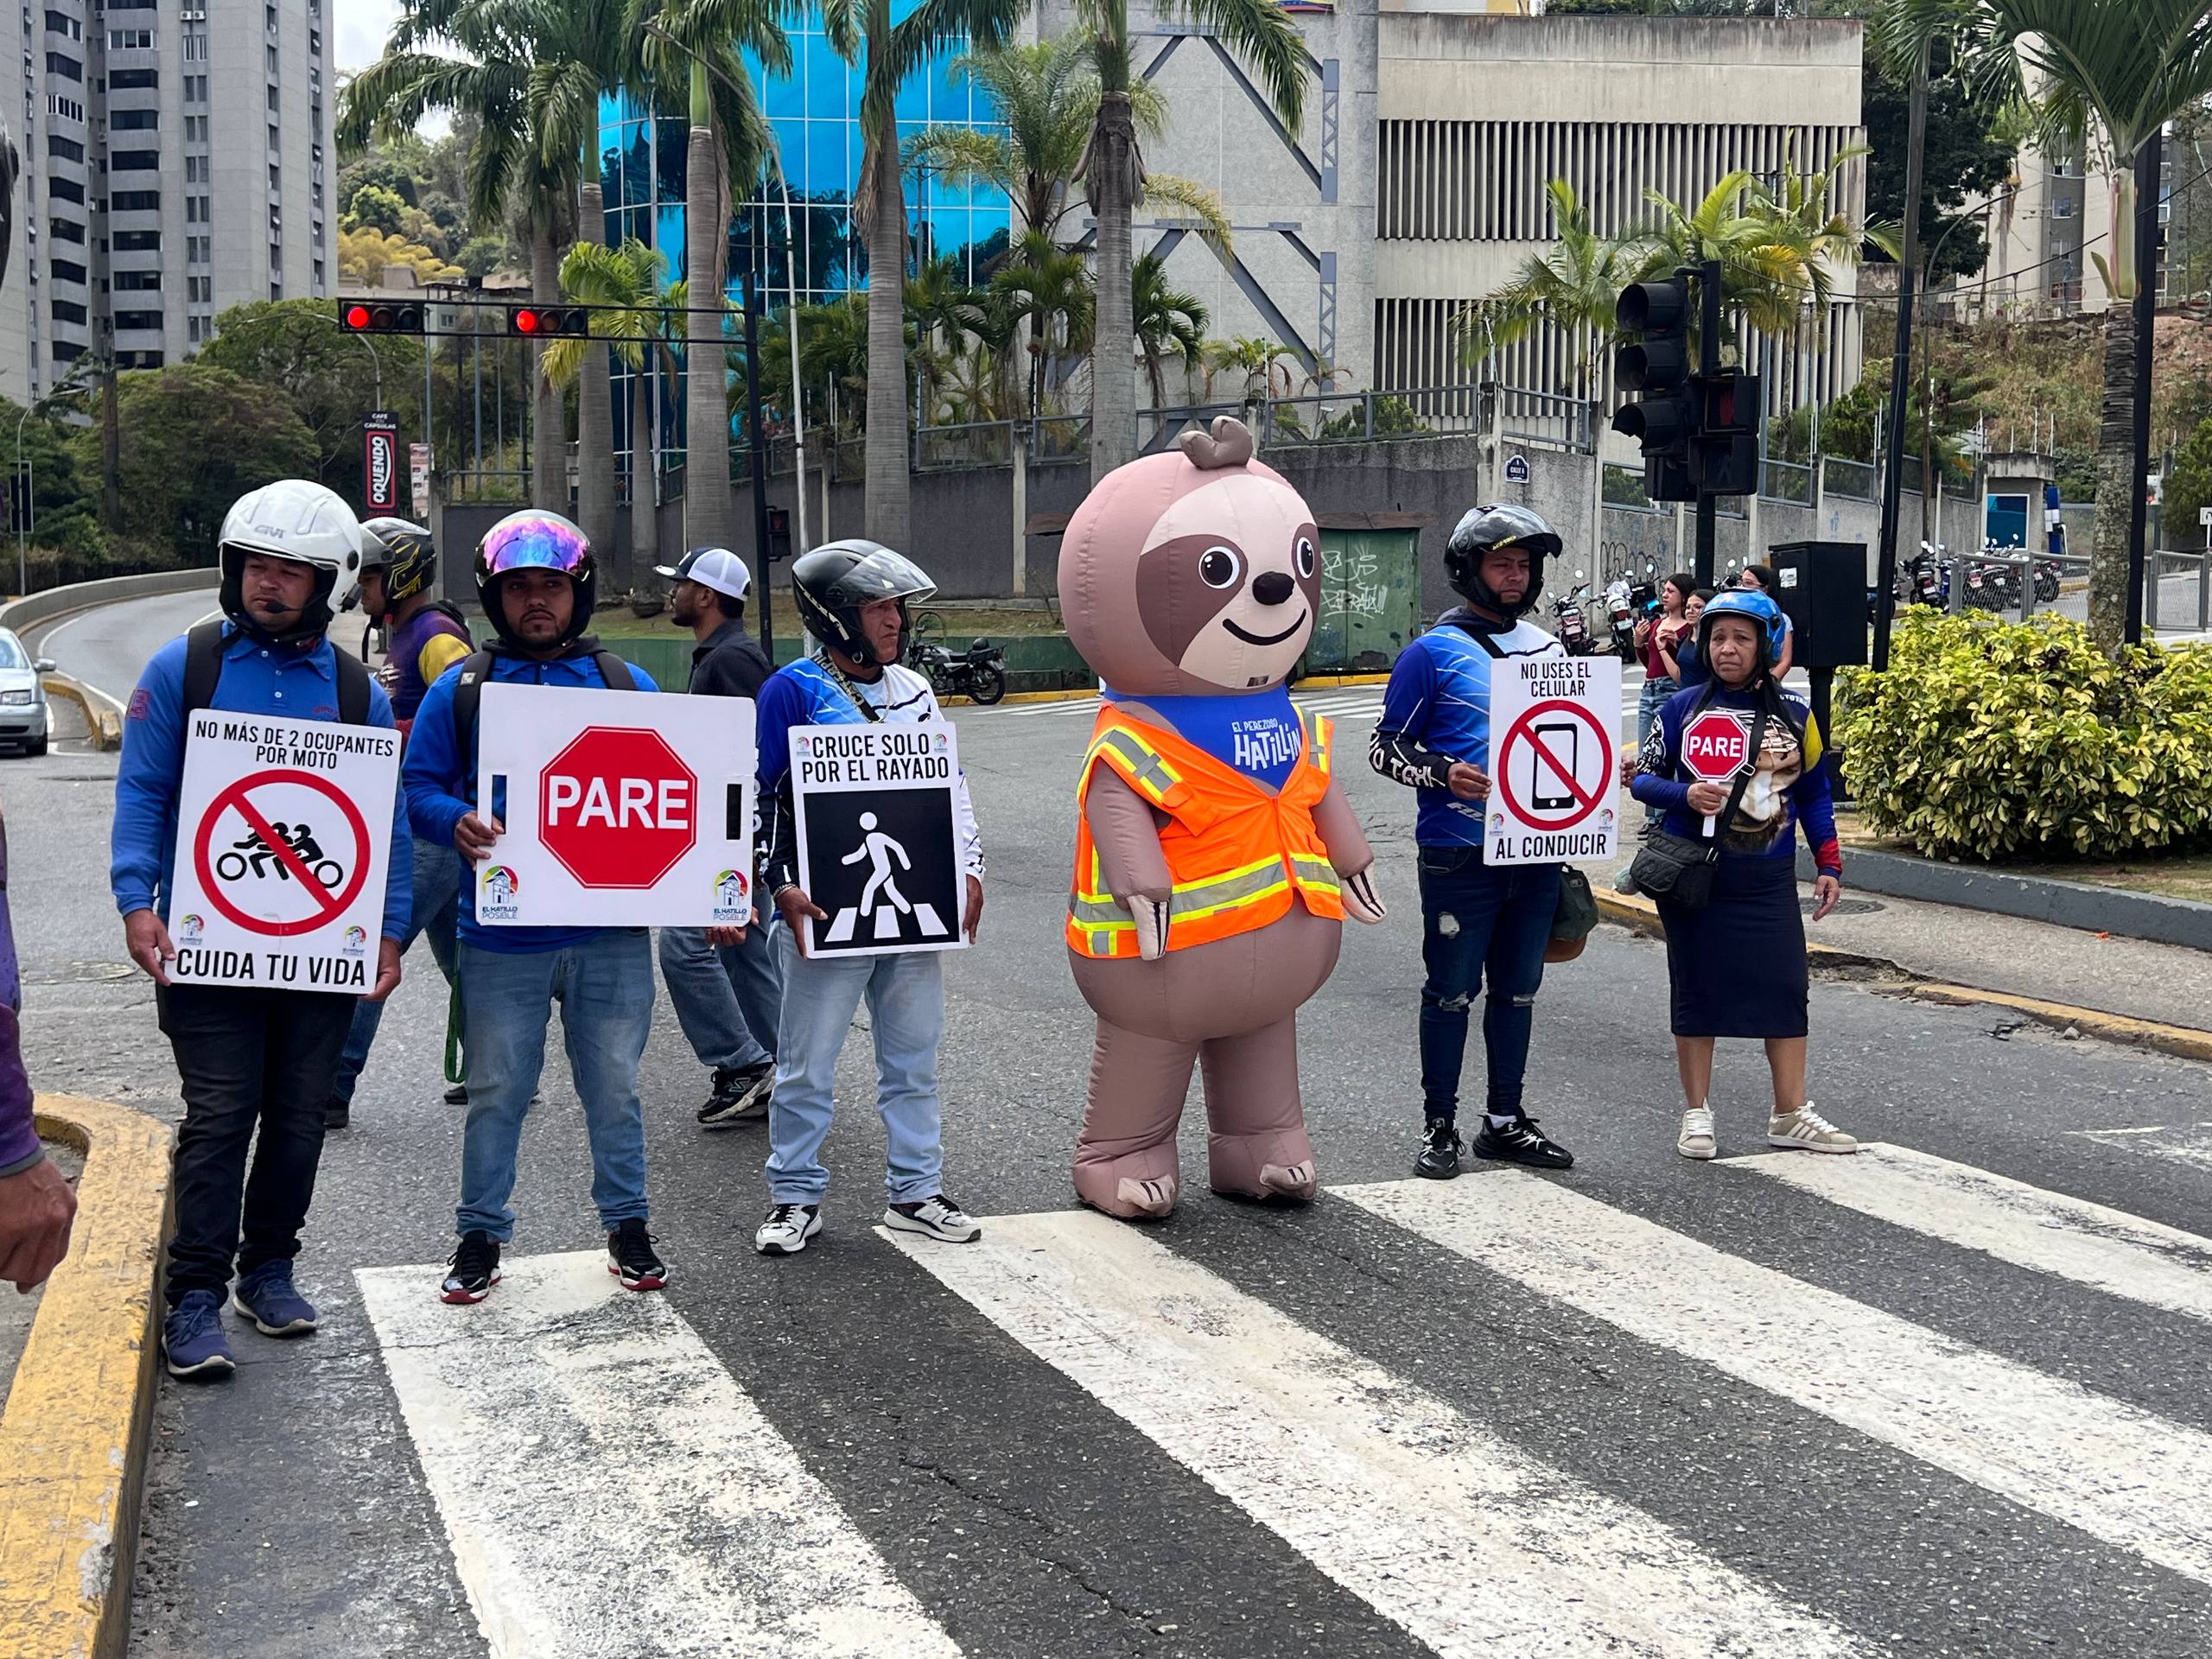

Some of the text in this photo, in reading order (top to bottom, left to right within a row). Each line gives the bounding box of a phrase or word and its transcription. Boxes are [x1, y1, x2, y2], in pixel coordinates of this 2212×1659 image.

[372, 436, 385, 504] OQUENDO
[1521, 662, 1592, 679] NO USES EL
[1531, 680, 1586, 697] CELULAR
[195, 721, 393, 757] NO MÁS DE 2 OCUPANTES
[1231, 721, 1243, 733] EL
[256, 745, 338, 769] POR MOTO
[812, 734, 930, 759] CRUCE SOLO
[1688, 735, 1742, 757] PARE
[802, 756, 950, 783] POR EL RAYADO
[548, 775, 689, 830] PARE
[1496, 834, 1606, 859] AL CONDUCIR
[176, 948, 365, 986] CUIDA TU VIDA
